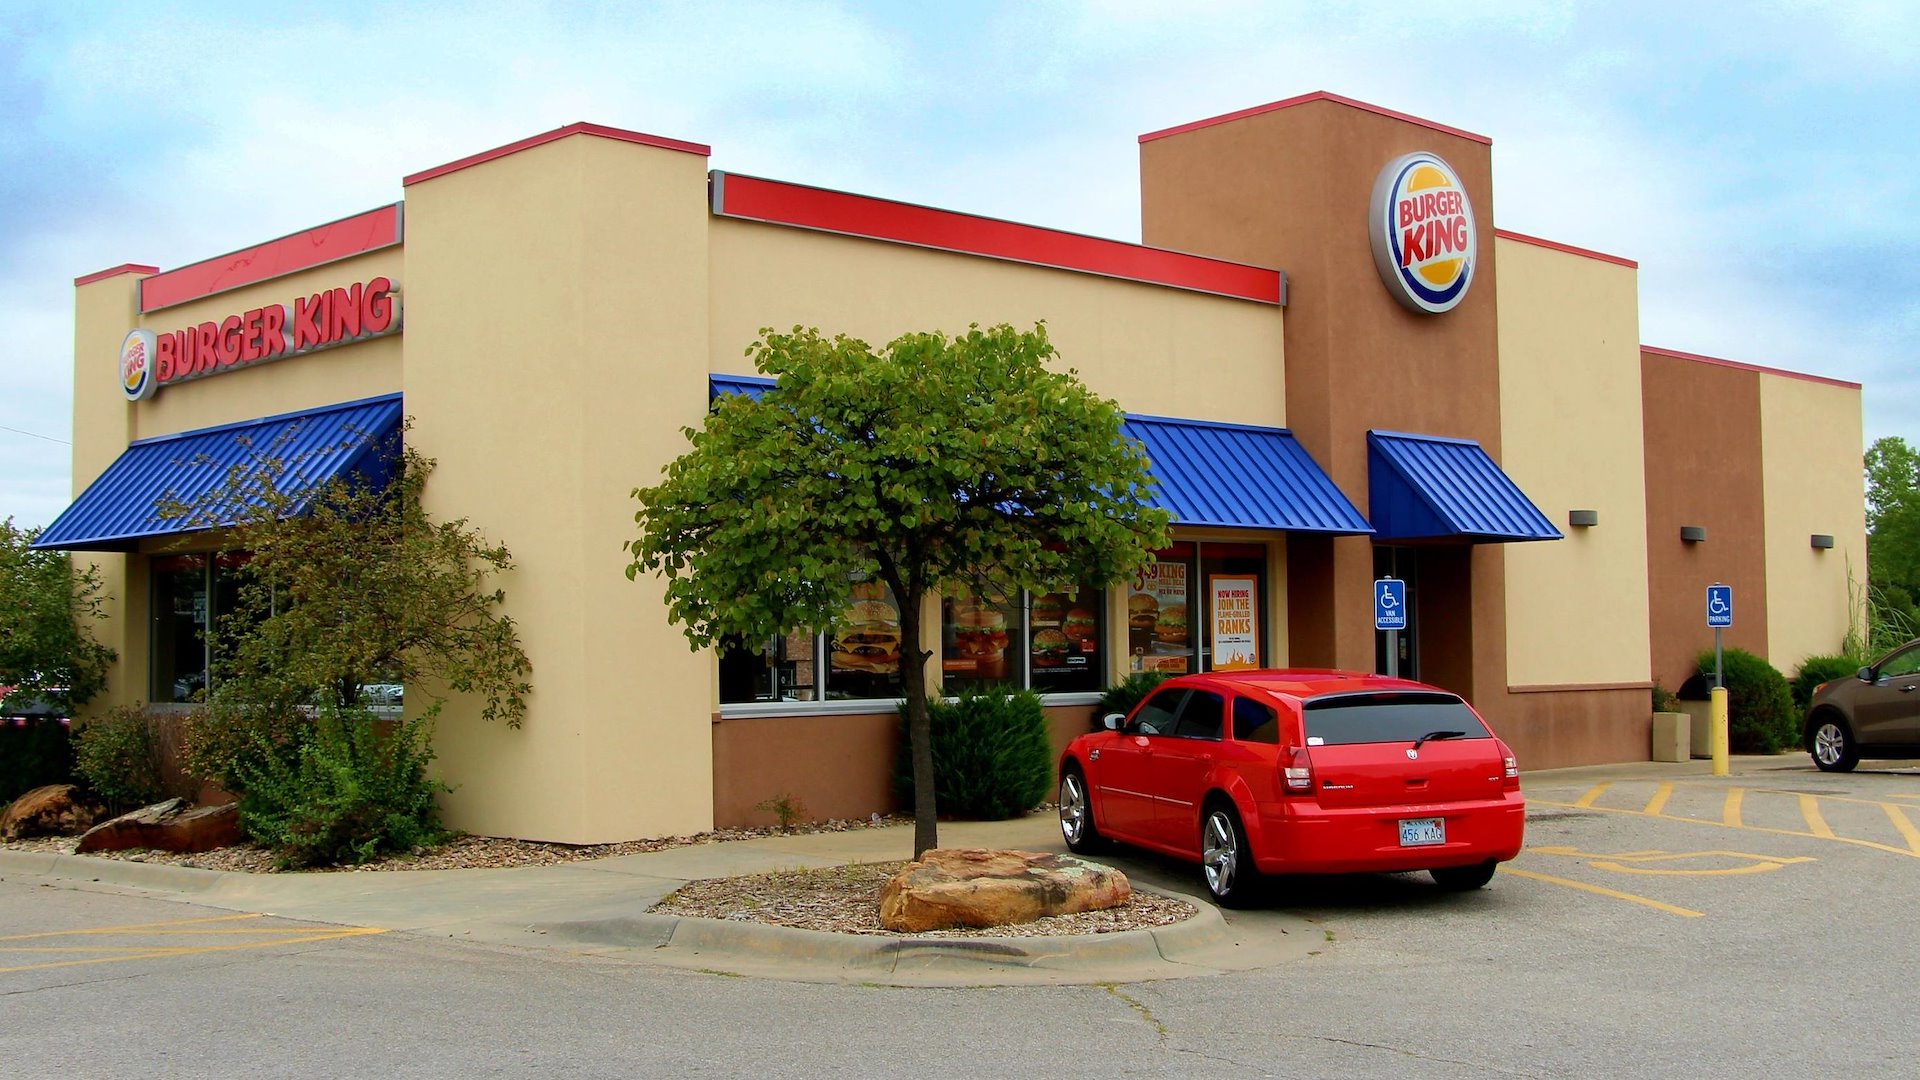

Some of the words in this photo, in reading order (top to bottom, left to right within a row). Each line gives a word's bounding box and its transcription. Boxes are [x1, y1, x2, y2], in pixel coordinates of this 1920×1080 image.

[1400, 191, 1464, 228] BURGER
[1403, 216, 1467, 266] KING
[156, 304, 286, 382] BURGER
[294, 277, 392, 350] KING
[1159, 564, 1185, 578] KING
[1218, 590, 1231, 598] NOW
[1231, 590, 1249, 598] HIRING
[1218, 599, 1234, 610] JOIN
[1236, 599, 1249, 610] THE
[1709, 615, 1730, 623] PARKING
[1218, 619, 1251, 634] RANKS
[1402, 829, 1419, 841] 456
[1424, 827, 1442, 840] KAG
